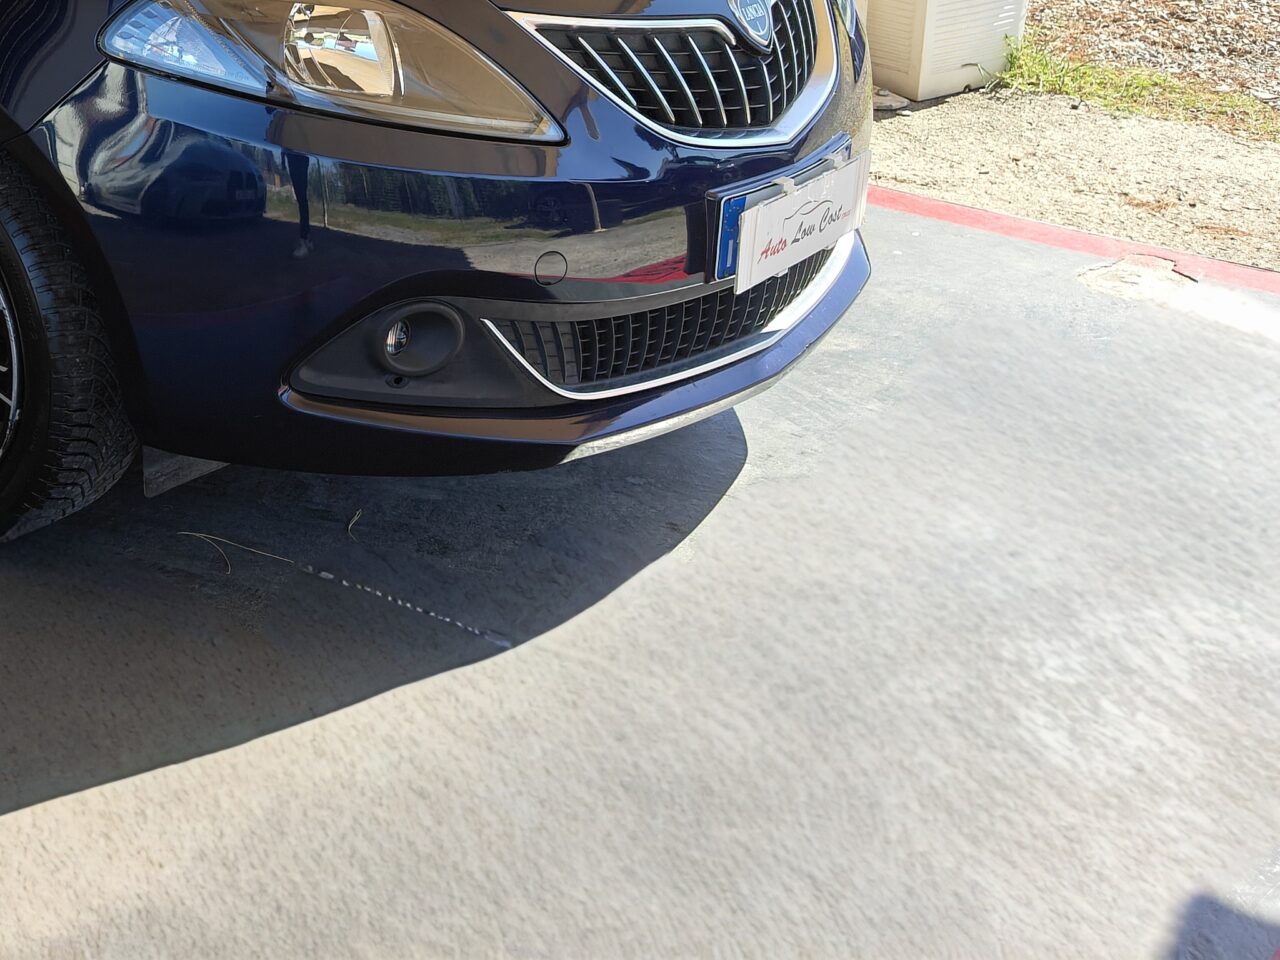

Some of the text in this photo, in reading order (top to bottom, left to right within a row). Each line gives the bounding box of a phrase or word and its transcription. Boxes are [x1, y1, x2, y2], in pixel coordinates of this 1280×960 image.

[742, 3, 764, 21] LANCIA
[757, 236, 788, 264] Auto
[791, 220, 815, 244] Low
[818, 204, 843, 232] Cost
